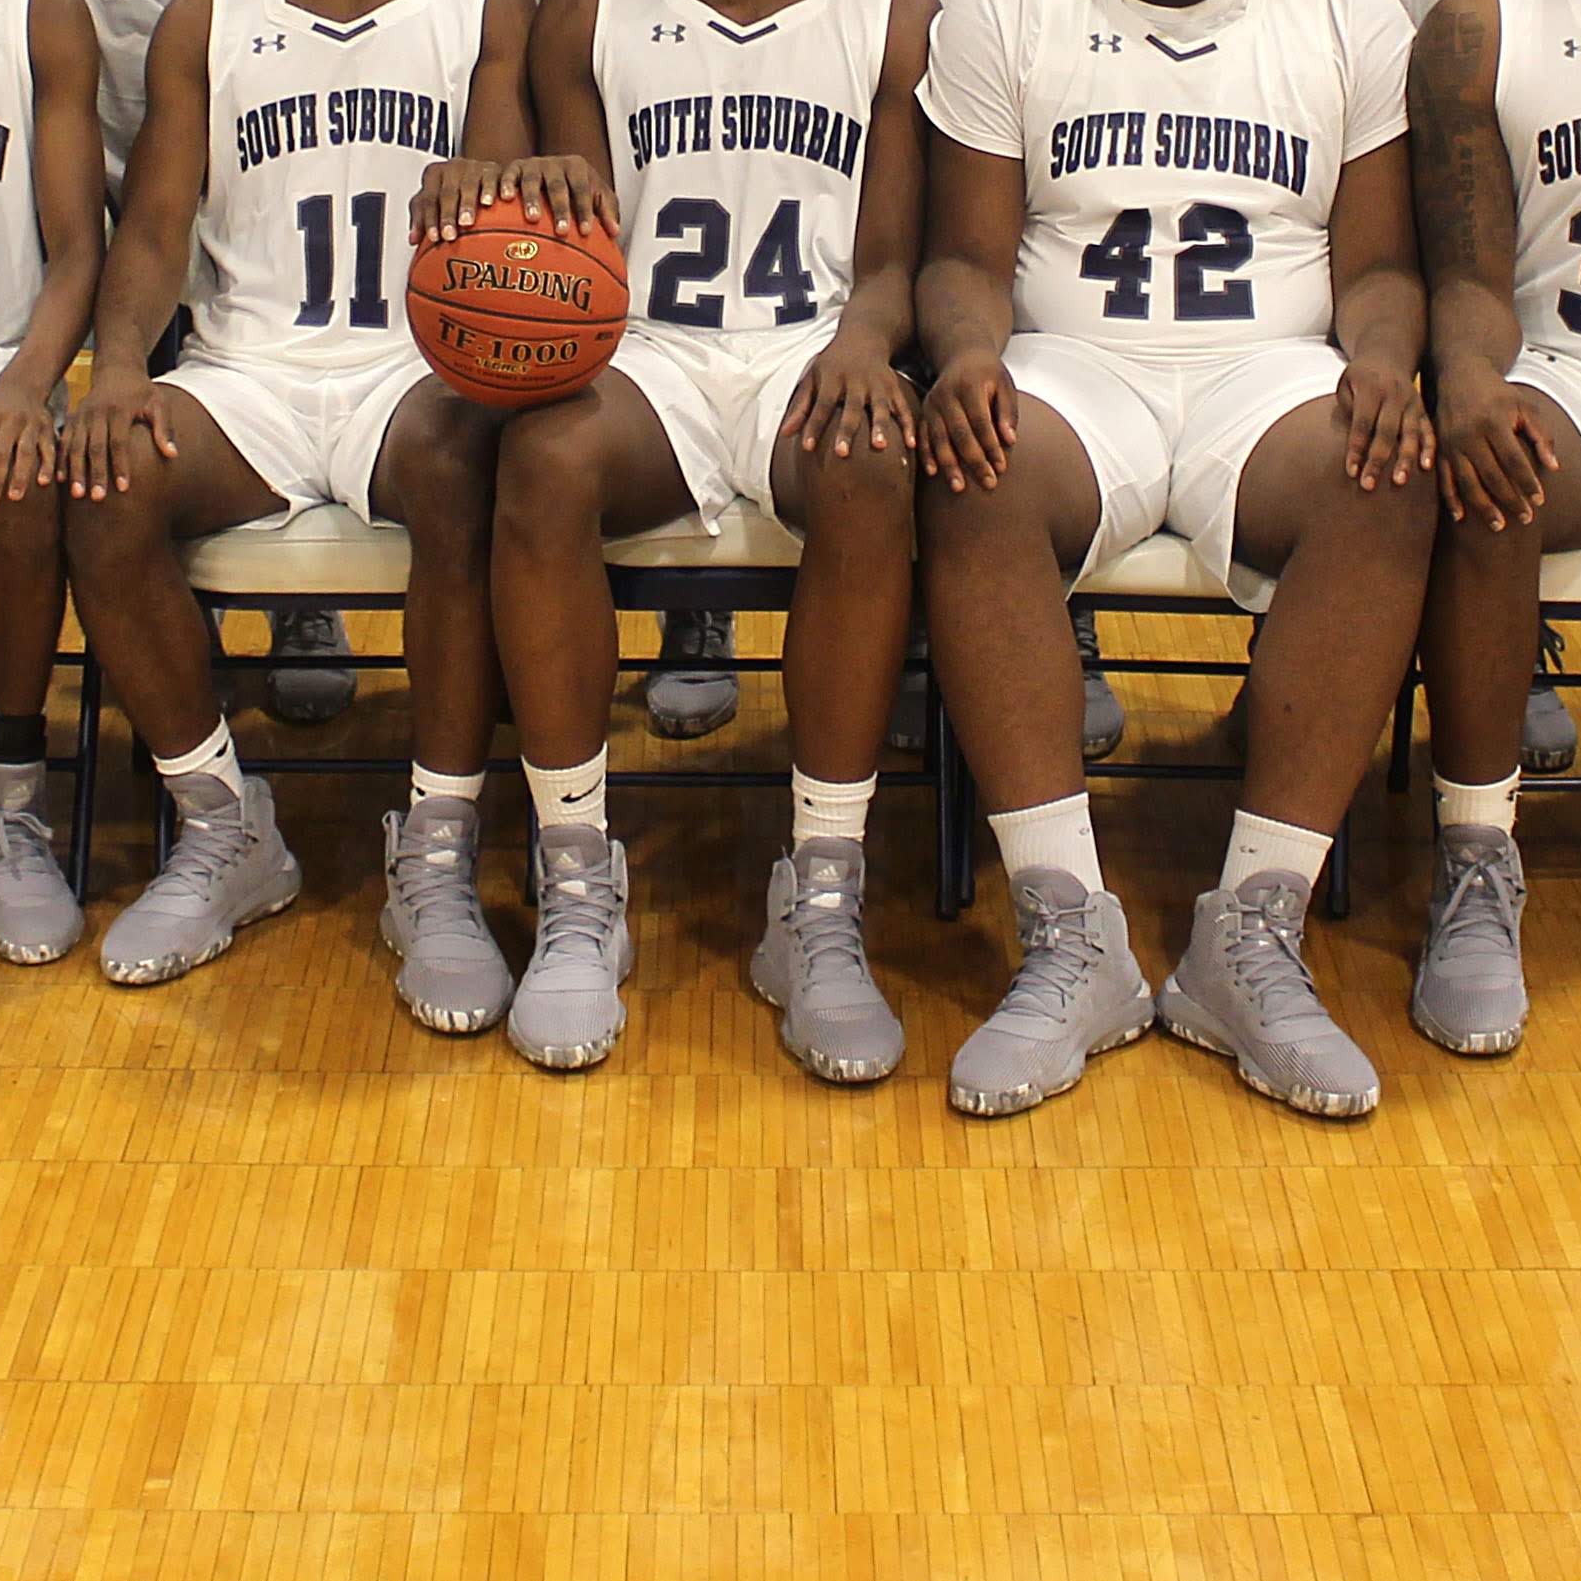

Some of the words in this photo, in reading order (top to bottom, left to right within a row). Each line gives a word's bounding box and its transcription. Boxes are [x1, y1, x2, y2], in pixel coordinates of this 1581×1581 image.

[236, 93, 318, 173] SOUTH
[328, 88, 456, 159] SUBURBA
[628, 96, 713, 172] SOUTH
[722, 95, 863, 180] SUBURBAN
[1050, 111, 1147, 180] SOUTH
[1155, 113, 1309, 197] SUBURBAN
[294, 192, 389, 329] 11
[442, 258, 593, 313] SPALDING
[647, 198, 819, 328] 24
[1079, 202, 1256, 321] 42
[438, 317, 578, 363] TF-1000
